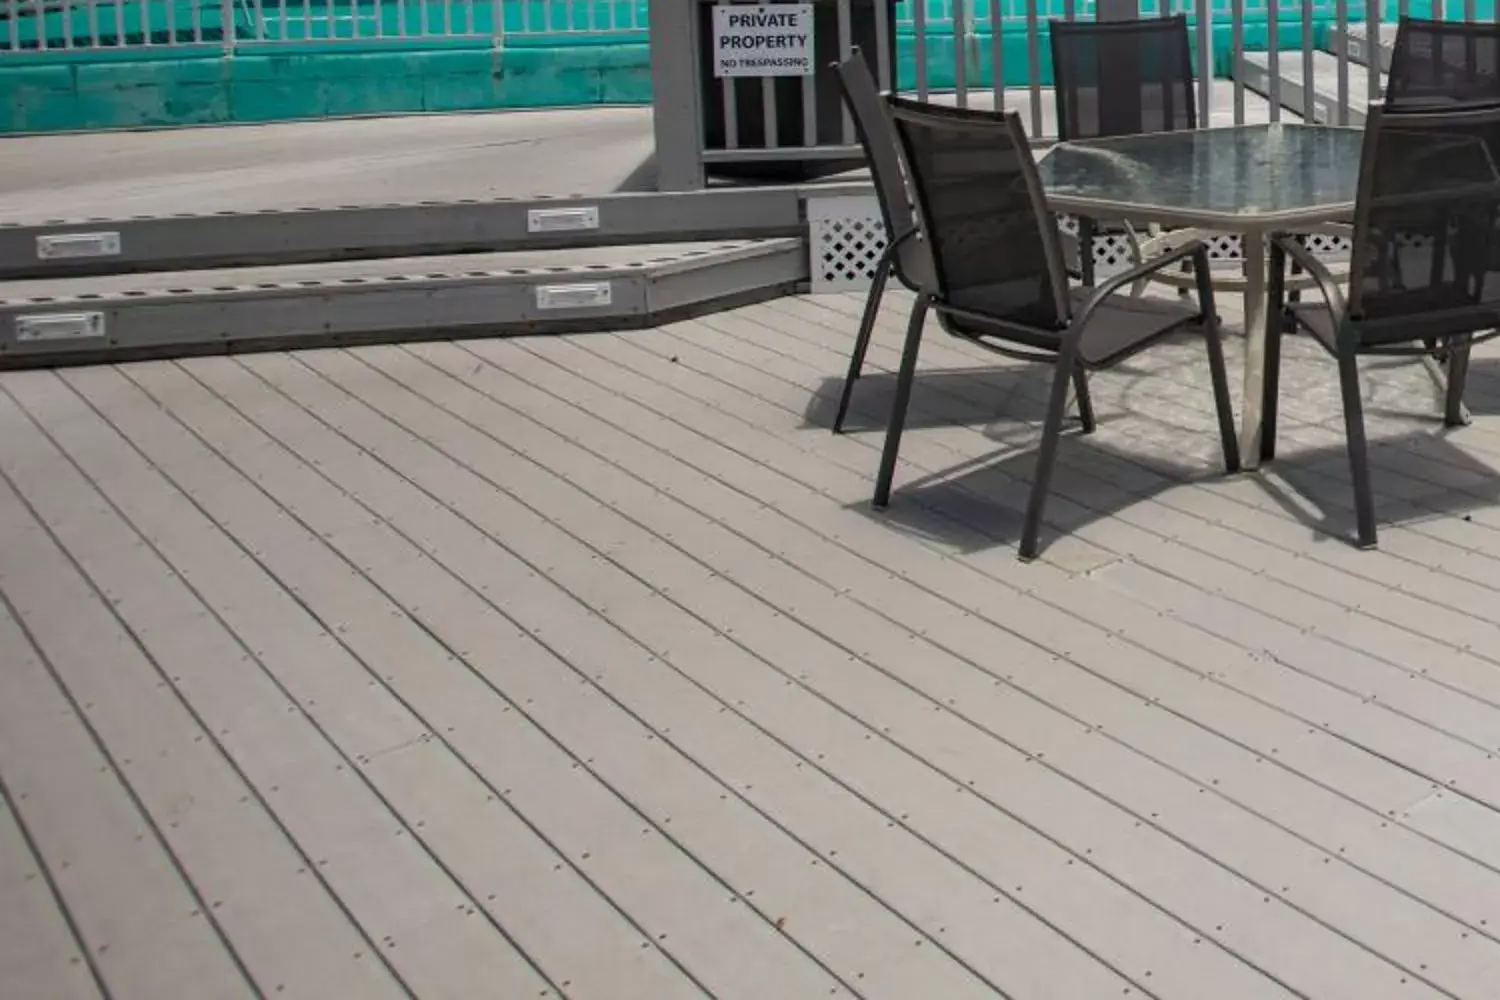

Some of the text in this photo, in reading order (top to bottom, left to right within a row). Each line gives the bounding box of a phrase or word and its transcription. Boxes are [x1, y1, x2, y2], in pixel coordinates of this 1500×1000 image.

[729, 14, 798, 27] PRIVATE
[720, 35, 807, 49] PROPERTY
[720, 58, 808, 68] NO TRESPASSING
